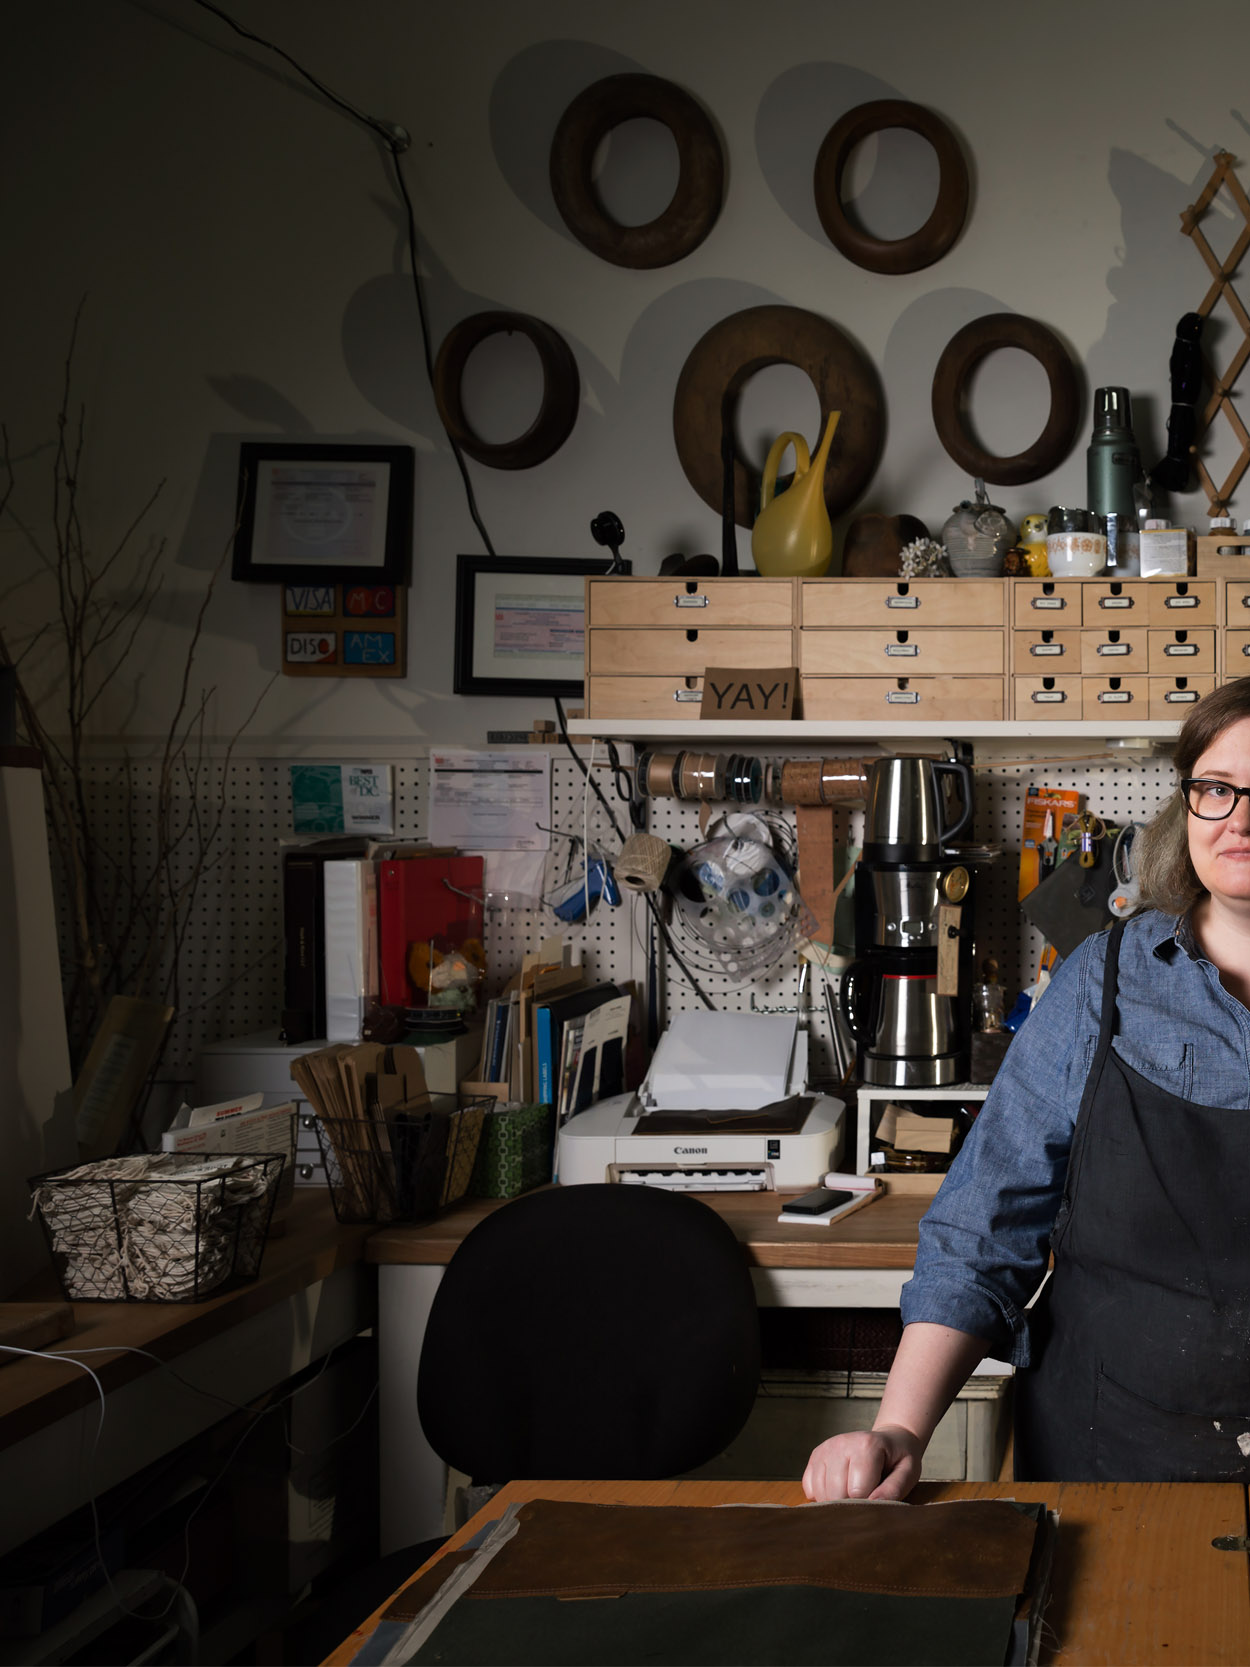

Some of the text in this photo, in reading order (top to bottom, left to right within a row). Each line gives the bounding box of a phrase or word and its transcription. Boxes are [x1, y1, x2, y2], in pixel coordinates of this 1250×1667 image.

[287, 585, 332, 611] VISA
[710, 682, 789, 710] YAY!
[348, 775, 379, 786] BEST
[1027, 797, 1077, 809] FISKARS
[673, 1146, 708, 1155] Canon
